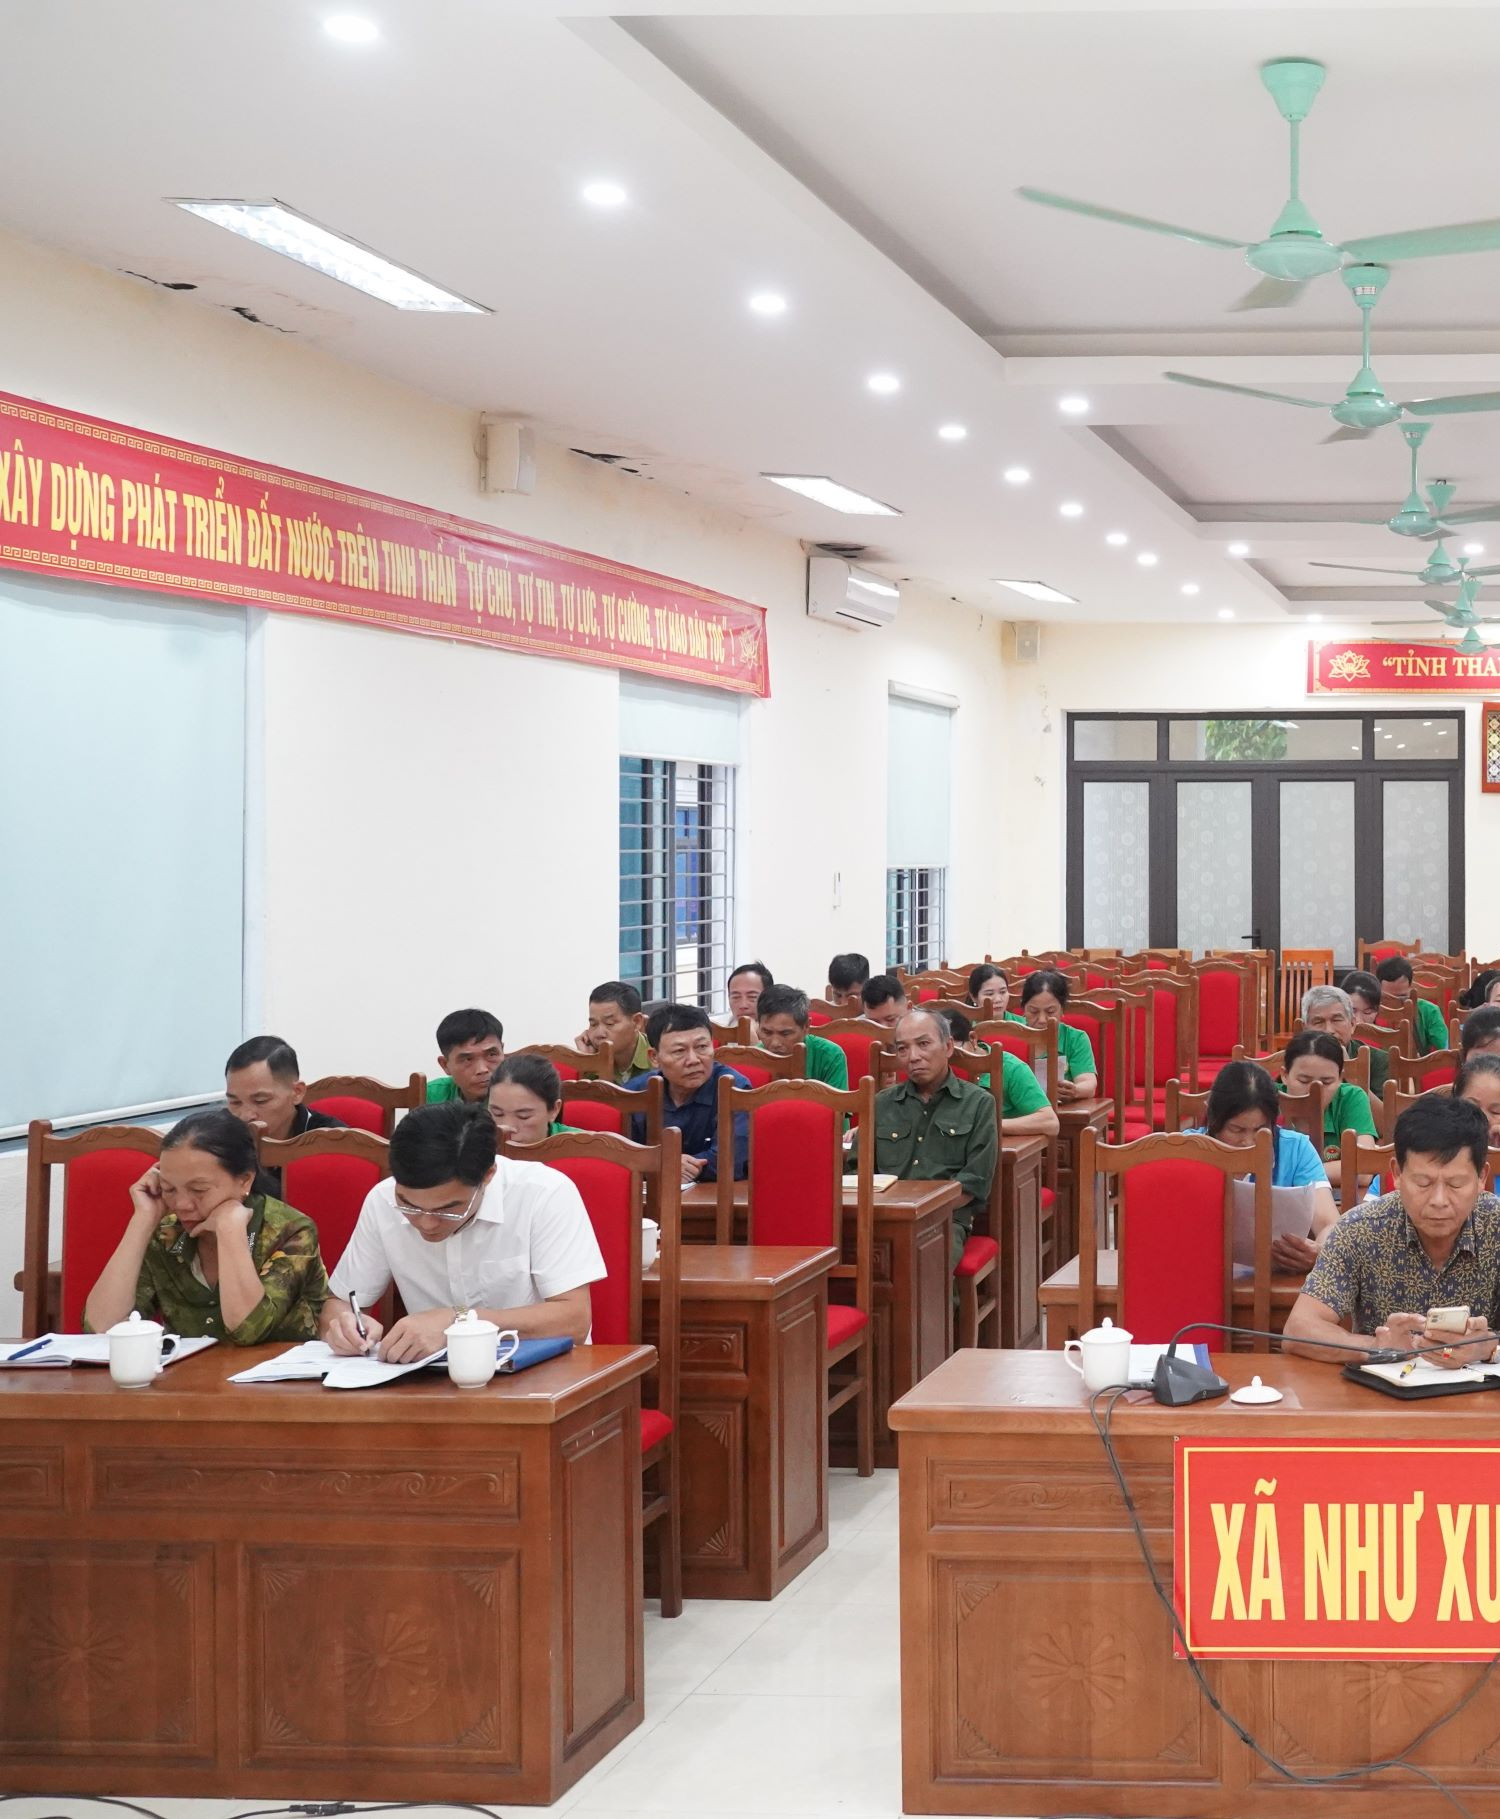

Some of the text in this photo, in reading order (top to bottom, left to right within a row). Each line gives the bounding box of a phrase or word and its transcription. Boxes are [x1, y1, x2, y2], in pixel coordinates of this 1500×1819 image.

[0, 439, 43, 527] XÂY
[51, 462, 114, 550] DỰNG
[121, 473, 177, 552] PHÁT
[183, 476, 241, 565] TRIỂN
[246, 492, 282, 573] ĐẤT
[286, 512, 334, 583] NƯỚC
[337, 523, 379, 591] TRÊN
[382, 540, 416, 598] TINH
[419, 537, 457, 607] THẦN
[518, 571, 534, 633] TỰ
[535, 577, 558, 634] TIN,
[560, 582, 575, 641] TỰ
[577, 586, 600, 644] LỰC,
[601, 592, 616, 649] TỰ
[617, 591, 654, 654] CƯỜNG,
[655, 605, 667, 660] TỰ
[668, 604, 688, 655] HÀO
[688, 609, 708, 659] DÂN
[1382, 649, 1447, 677] “TỈNH
[1210, 1478, 1286, 1621] XÃ
[1303, 1491, 1425, 1623] NHƯ
